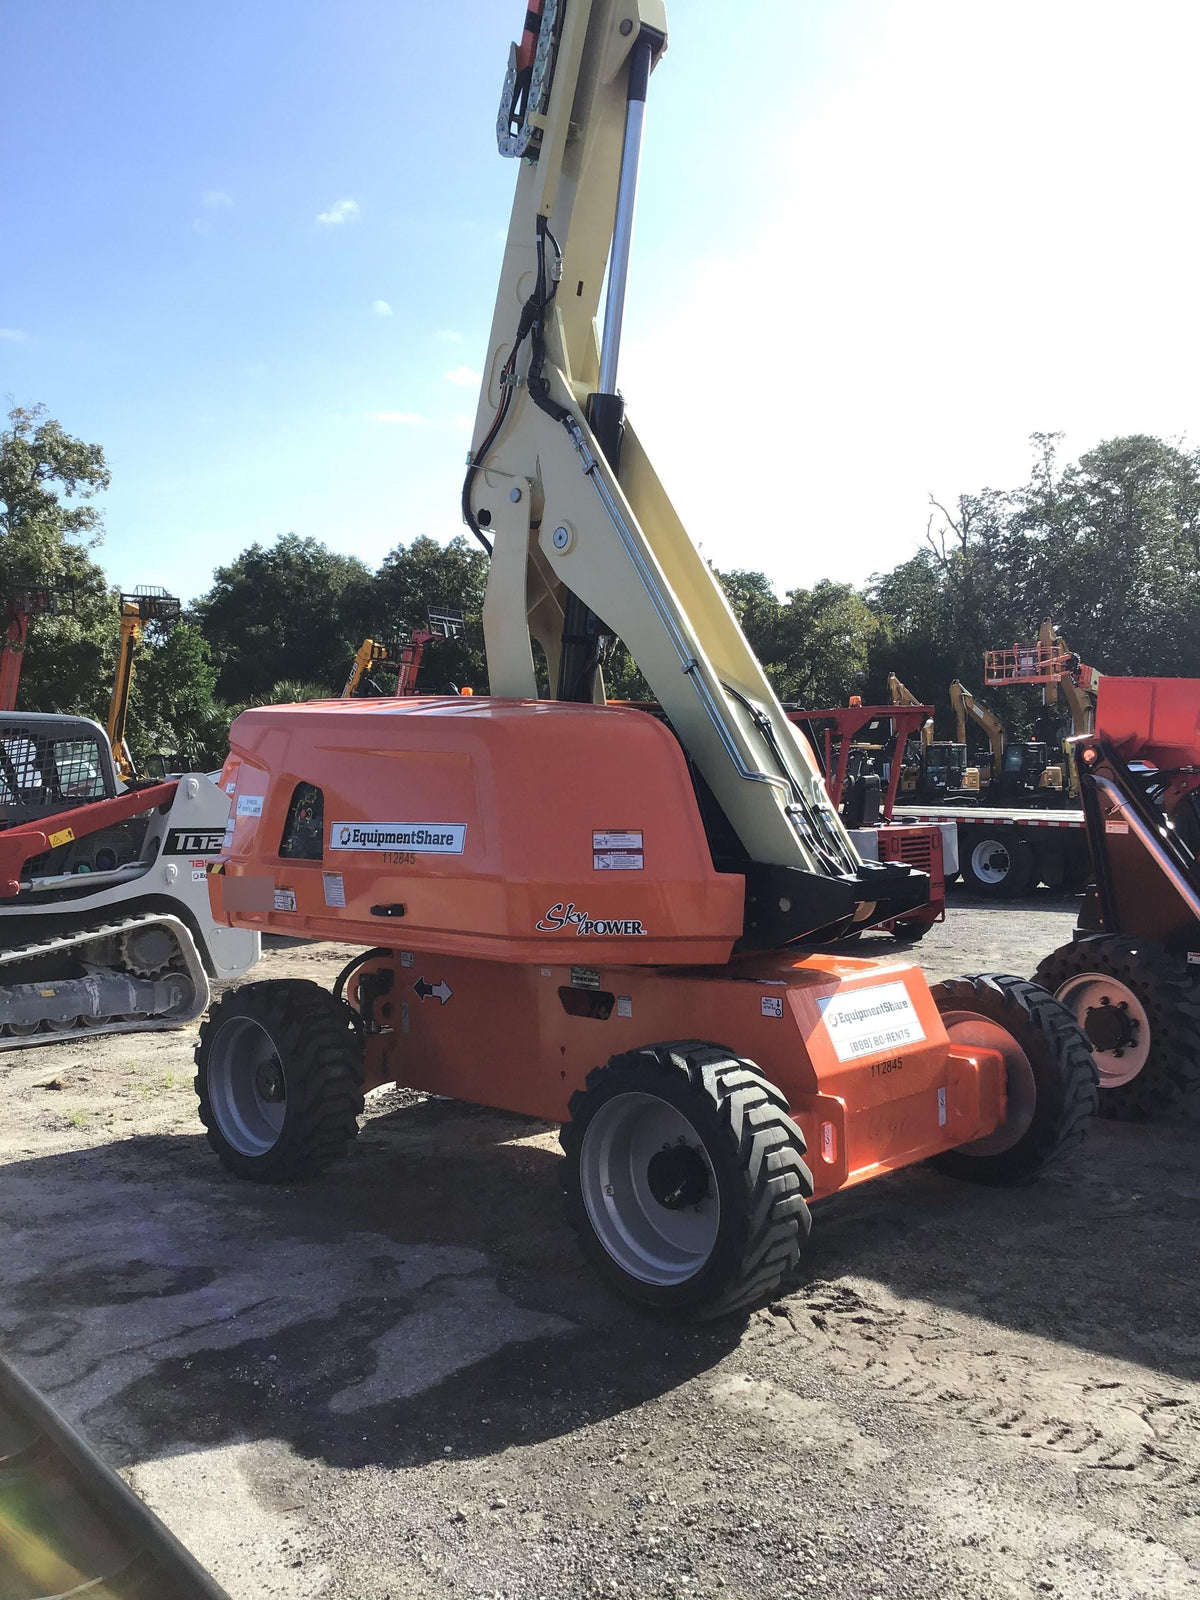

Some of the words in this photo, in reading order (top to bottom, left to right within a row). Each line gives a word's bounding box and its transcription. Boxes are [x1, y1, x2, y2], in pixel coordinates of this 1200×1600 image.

[352, 829, 455, 847] EquipmentShare
[382, 852, 416, 865] 112845
[837, 1000, 909, 1024] EquipmentShare
[849, 1039, 873, 1053] (888)
[871, 1057, 903, 1078] 112845
